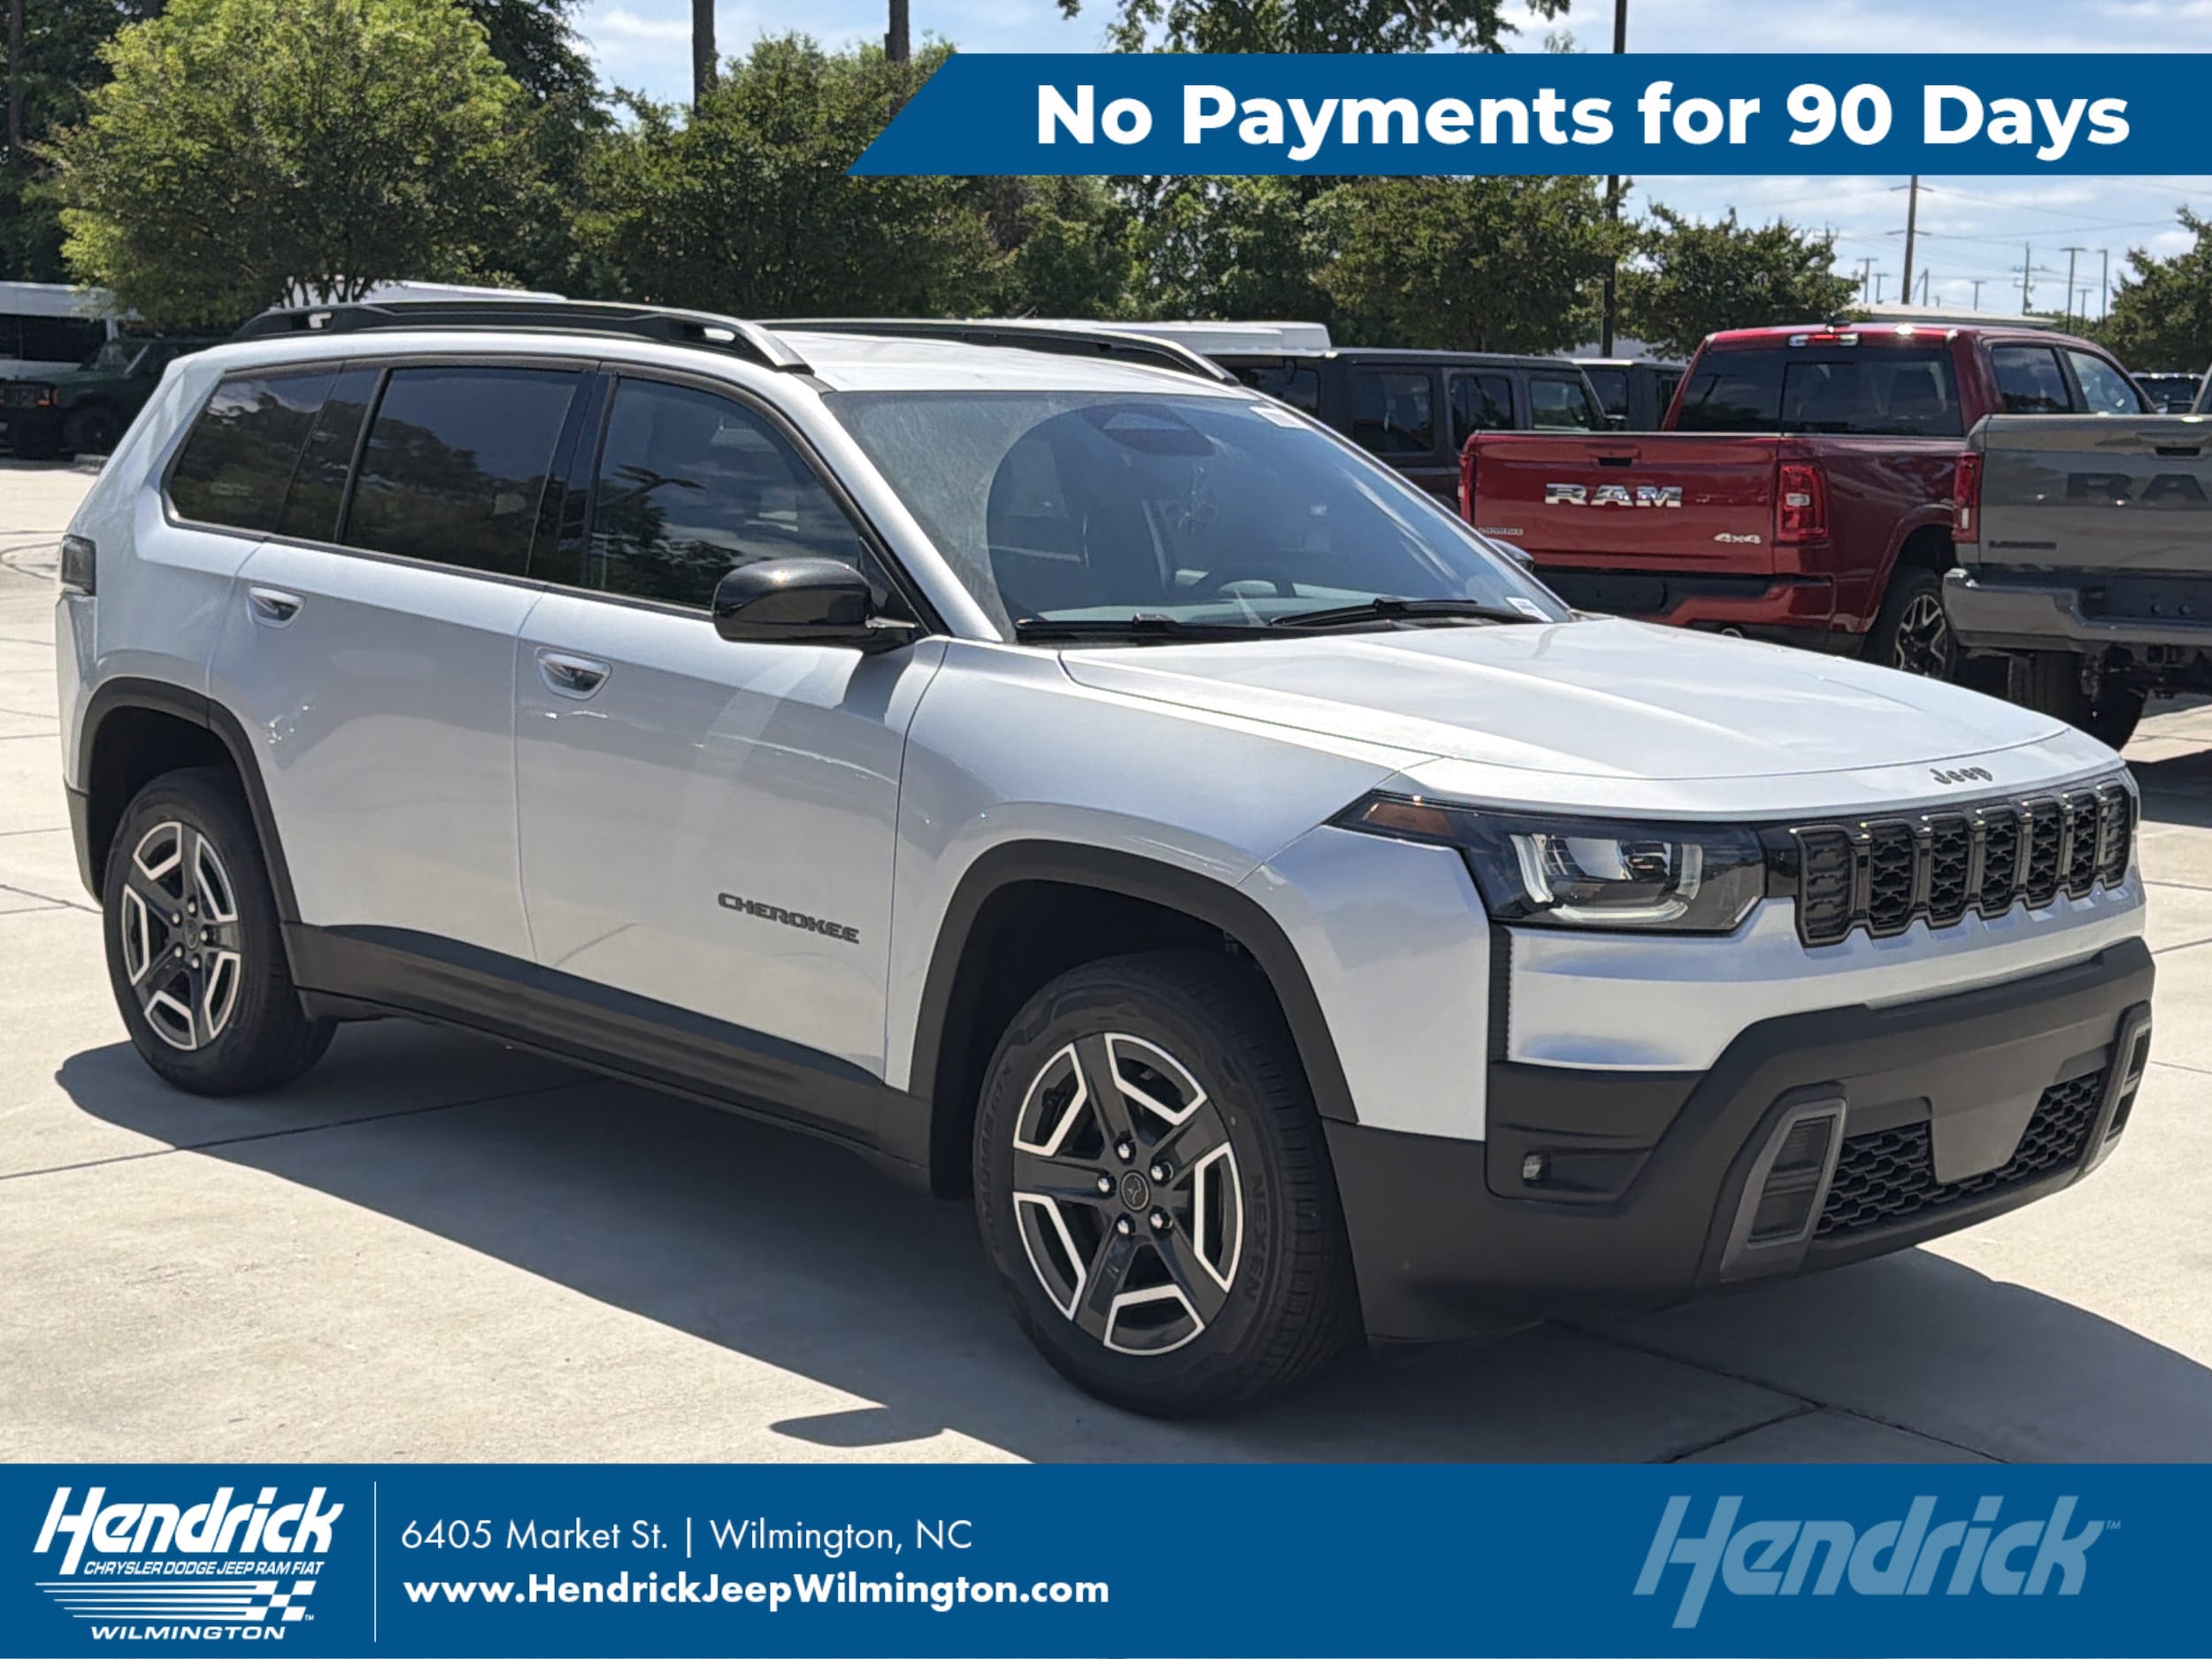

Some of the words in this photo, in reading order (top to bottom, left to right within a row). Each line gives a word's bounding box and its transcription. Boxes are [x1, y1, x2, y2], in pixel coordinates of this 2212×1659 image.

[1545, 483, 1683, 508] RAM
[1714, 533, 1762, 545] 4x4
[1929, 766, 1993, 785] Jeep
[718, 892, 859, 945] CHEROKEE
[1243, 1174, 1269, 1302] NEXEN
